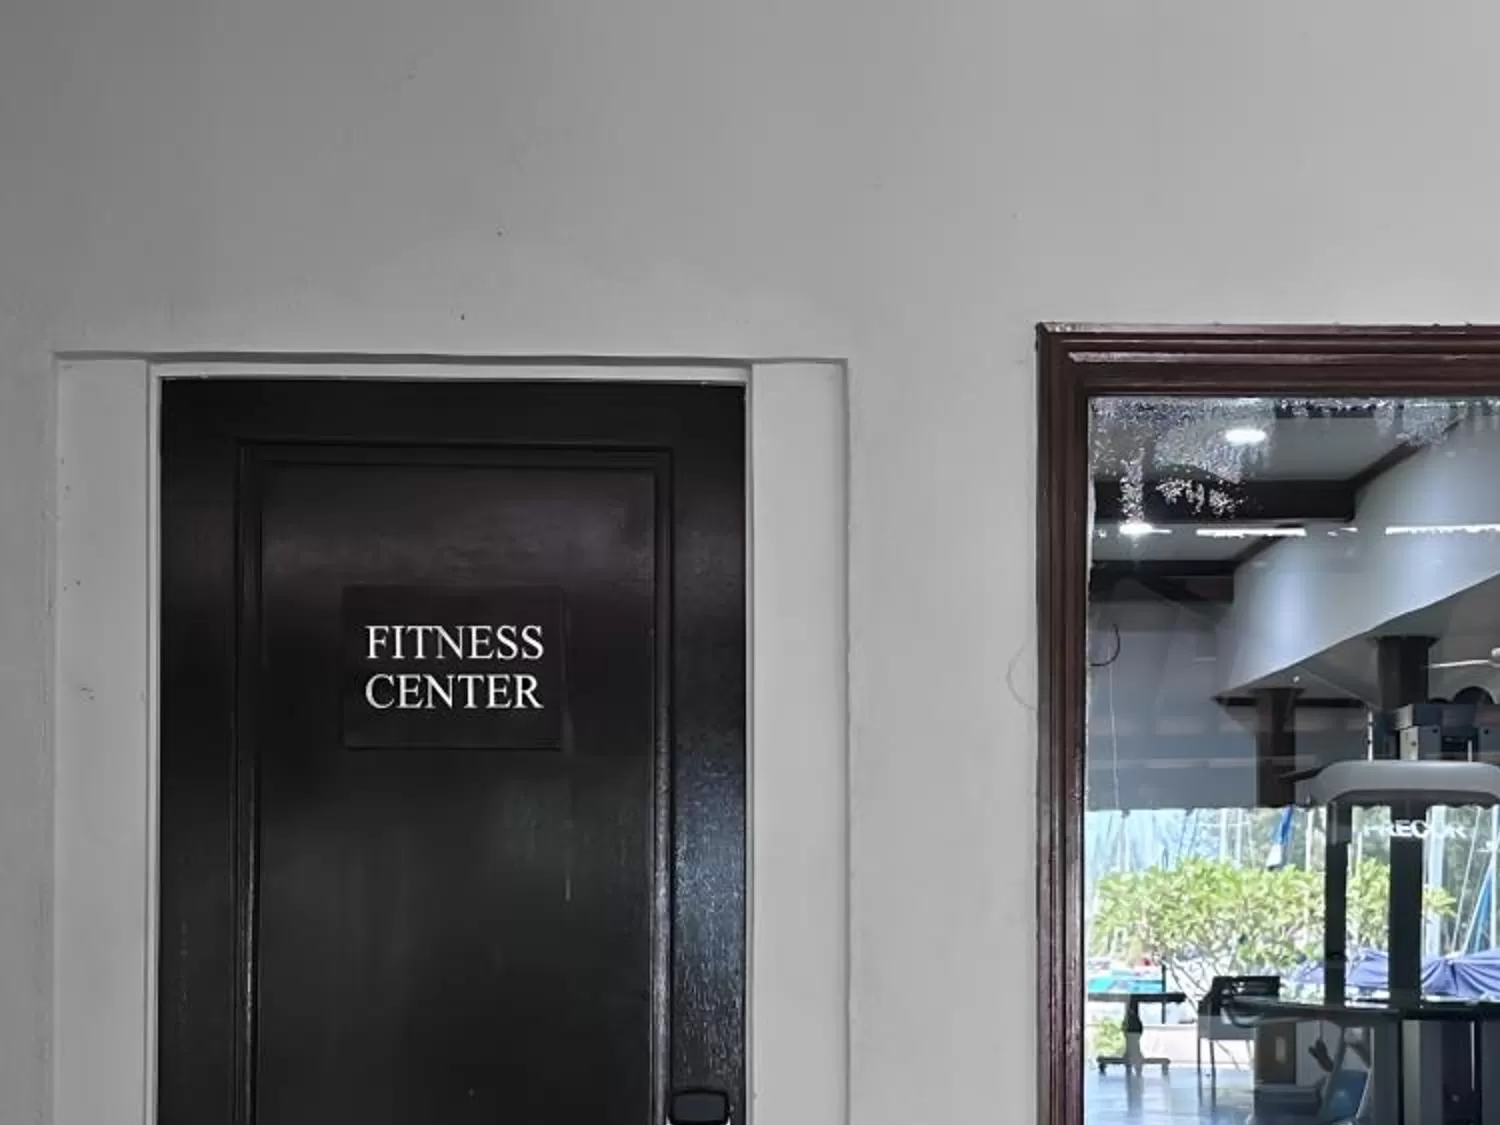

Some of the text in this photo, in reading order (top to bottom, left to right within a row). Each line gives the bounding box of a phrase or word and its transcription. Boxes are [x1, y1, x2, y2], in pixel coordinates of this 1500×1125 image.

[365, 624, 544, 660] FITNESS
[365, 672, 545, 709] CENTER
[1363, 819, 1467, 839] PRECR
